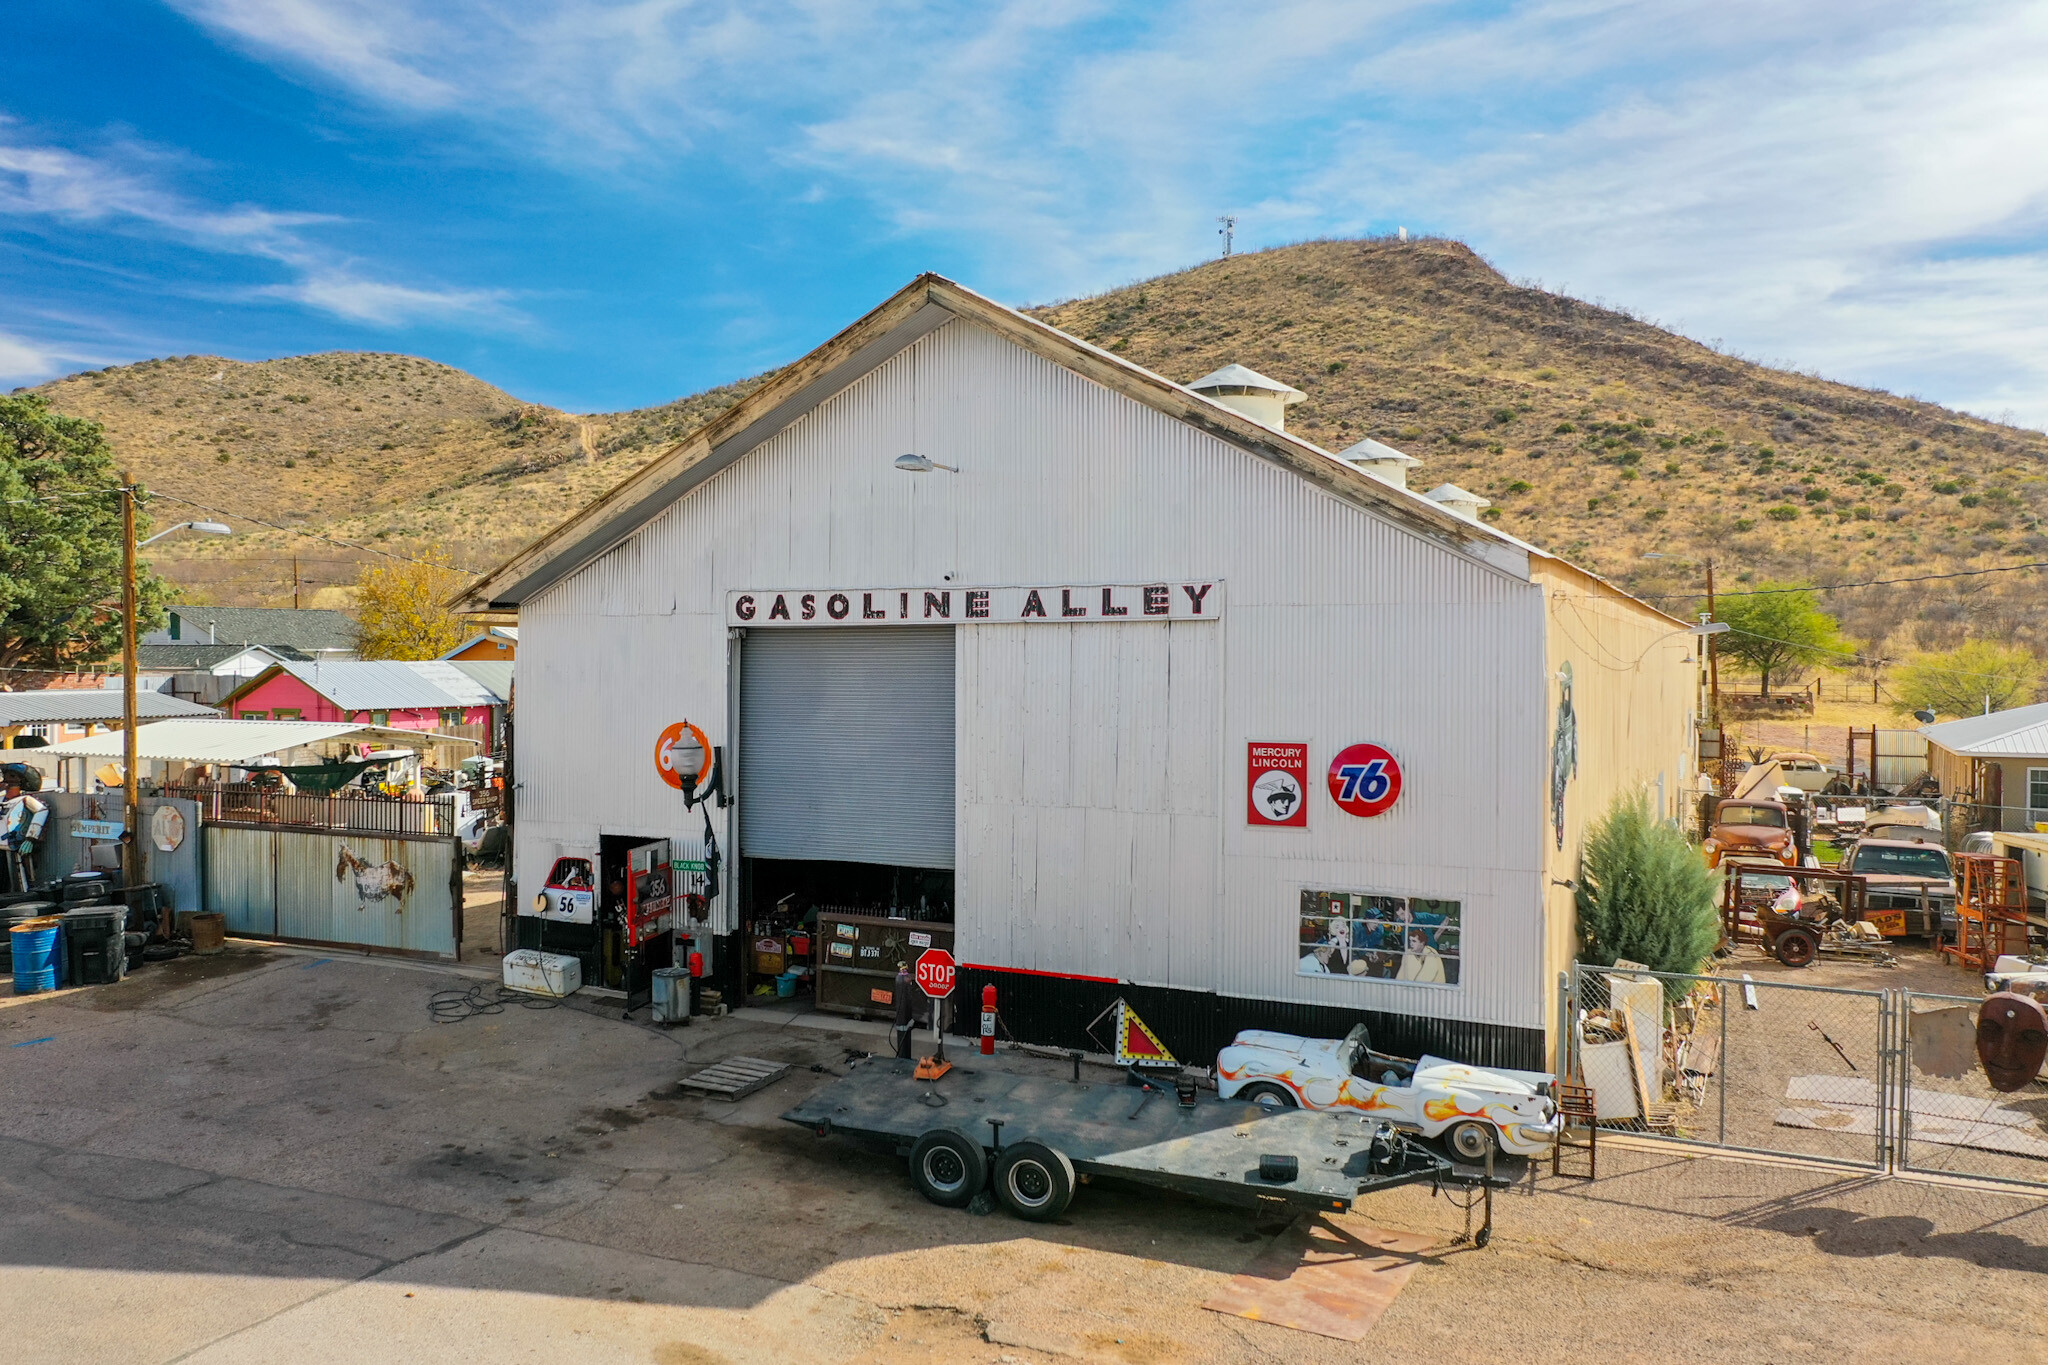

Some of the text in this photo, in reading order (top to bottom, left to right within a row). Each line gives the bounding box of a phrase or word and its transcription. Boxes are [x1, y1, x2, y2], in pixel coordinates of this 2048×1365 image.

[735, 584, 1213, 621] GASOLINE ALLEY
[1252, 747, 1302, 758] MERCURY
[1252, 758, 1302, 769] LINCOLN
[1336, 759, 1391, 803] 76
[673, 862, 705, 871] BLACK KNOB
[691, 874, 705, 887] 14
[559, 896, 574, 913] 56
[918, 962, 956, 983] STOP
